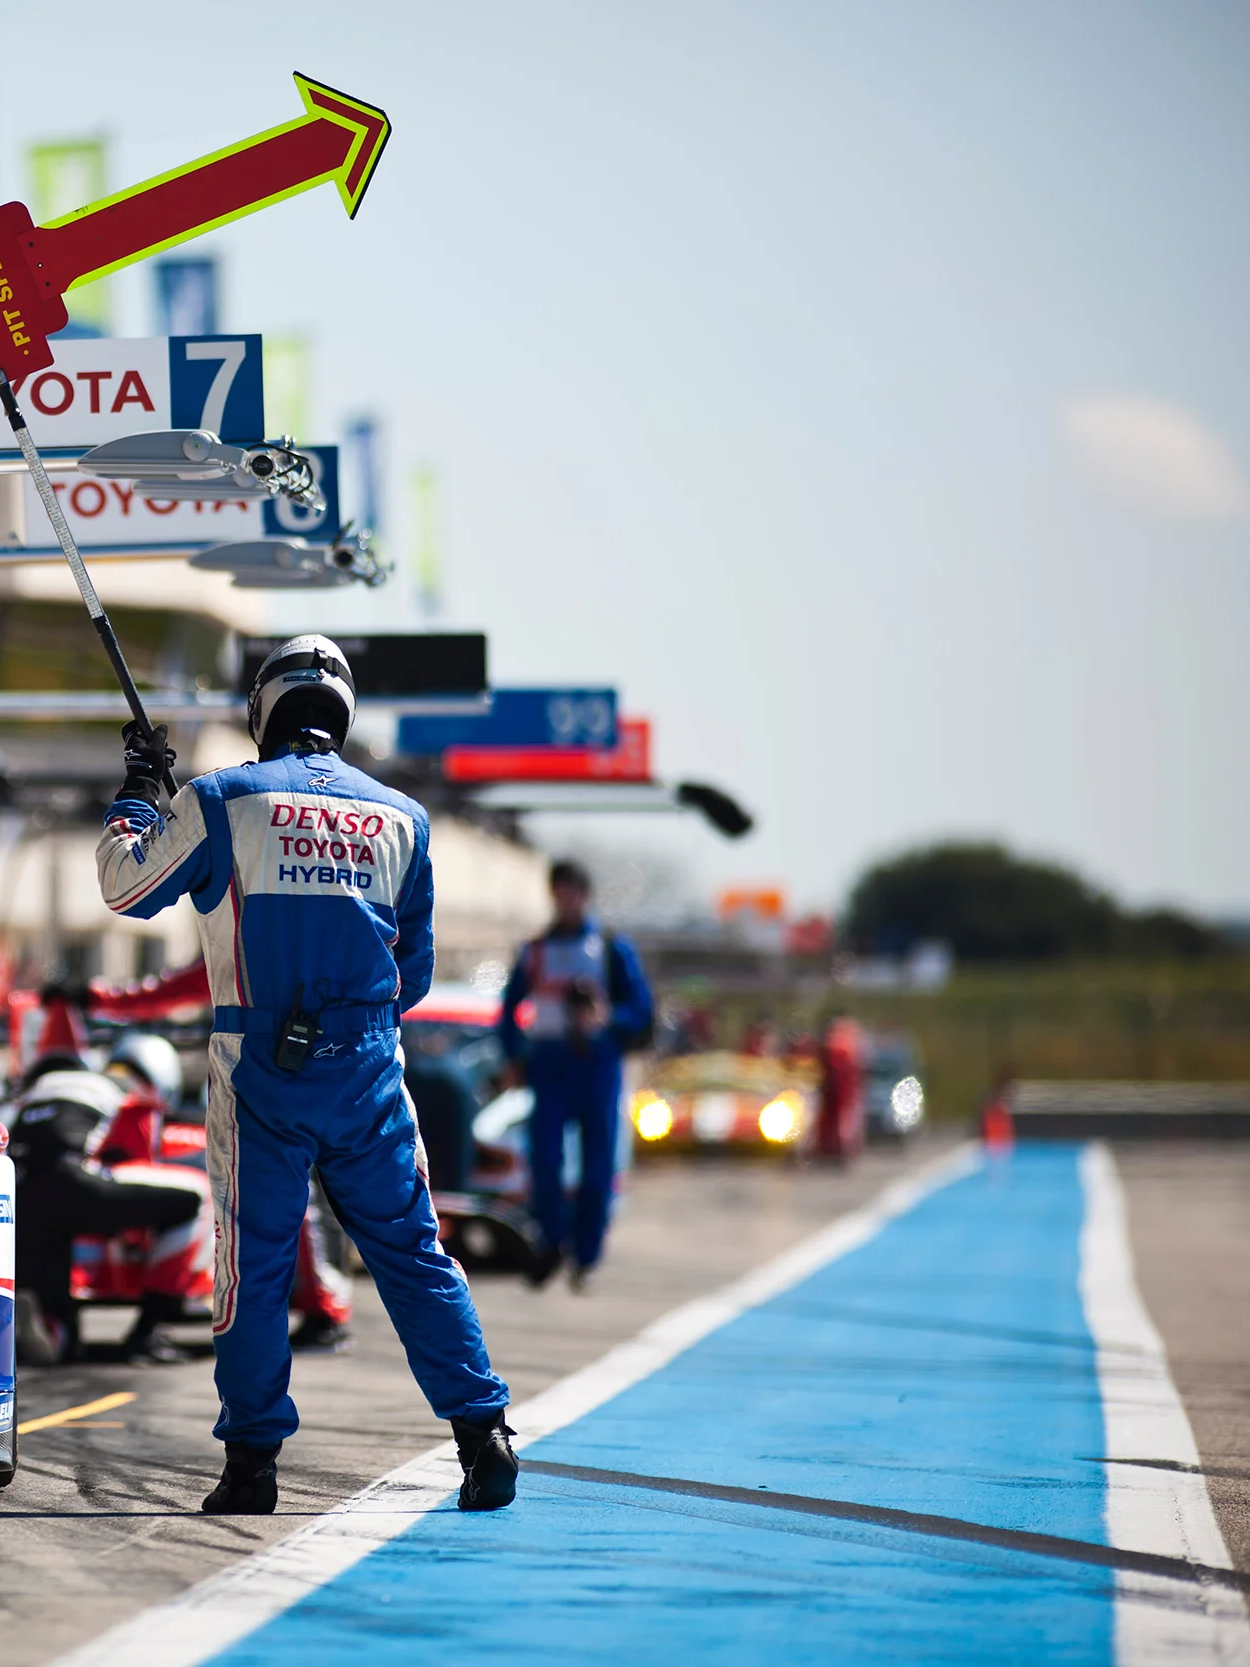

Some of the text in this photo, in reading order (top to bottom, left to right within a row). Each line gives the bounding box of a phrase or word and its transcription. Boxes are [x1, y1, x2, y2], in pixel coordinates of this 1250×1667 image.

[2, 310, 31, 347] PIT
[185, 340, 246, 431] 7
[270, 803, 384, 838] DENSO
[278, 836, 375, 866] TOYOTA
[278, 864, 372, 889] HYBRID
